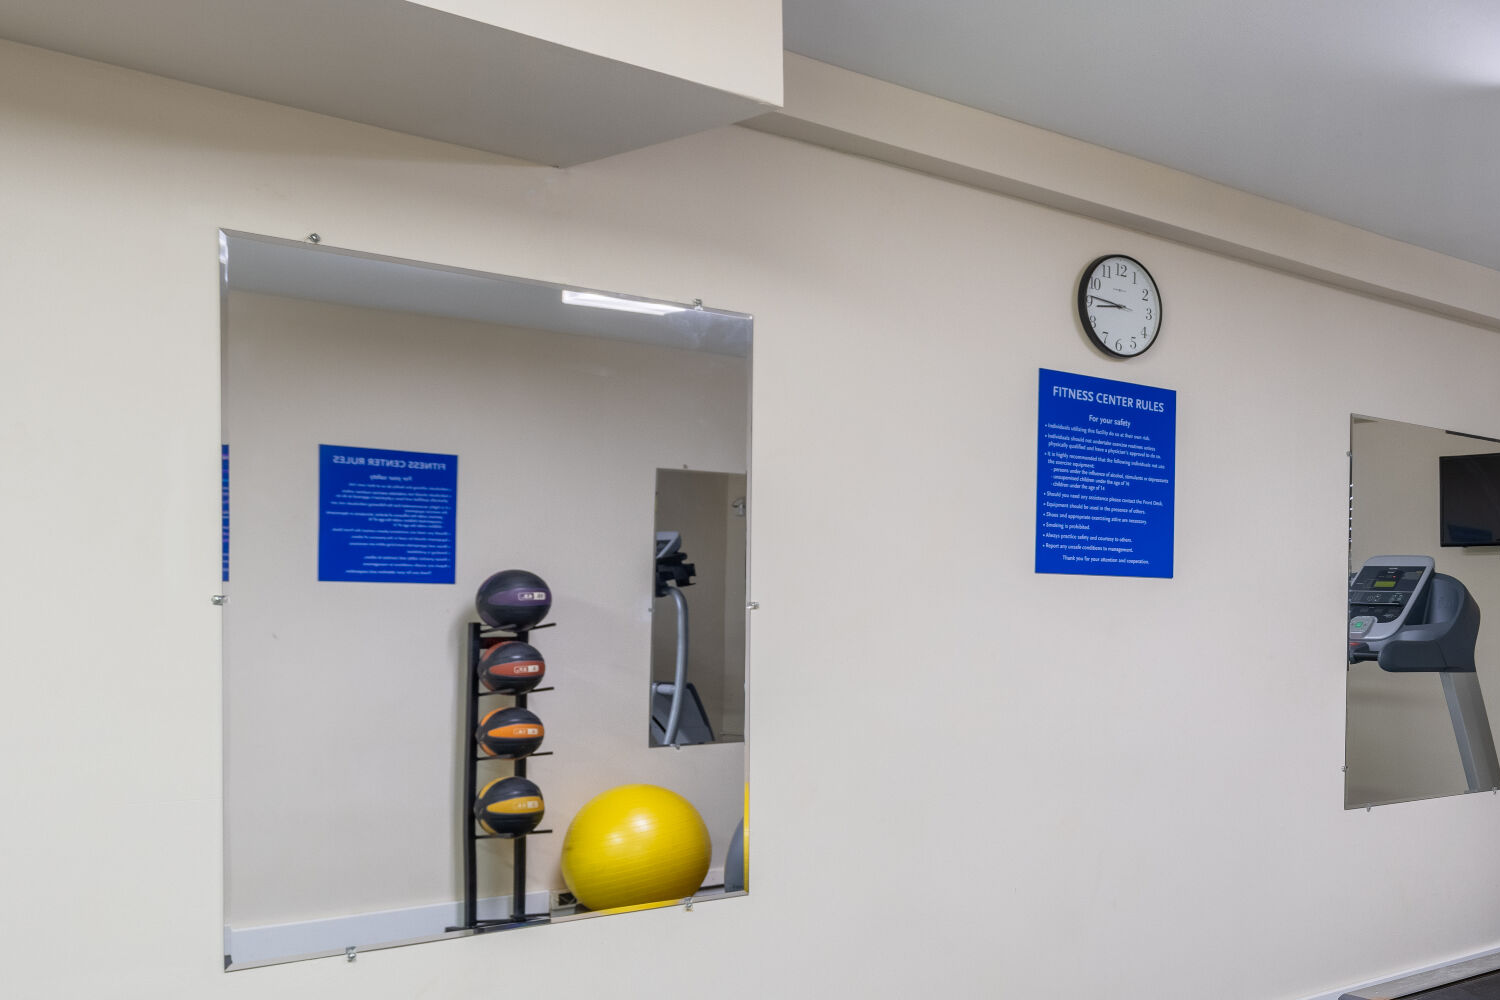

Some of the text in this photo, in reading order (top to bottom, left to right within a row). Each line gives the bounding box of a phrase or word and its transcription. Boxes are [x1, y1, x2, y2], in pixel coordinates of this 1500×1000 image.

[1102, 264, 1111, 278] 11
[1116, 262, 1128, 278] 12
[1090, 278, 1101, 290] 10
[1132, 272, 1137, 284] 1
[1086, 295, 1094, 307] 9
[1142, 289, 1149, 302] 2
[1146, 308, 1153, 320] 3
[1090, 315, 1097, 329] 8
[1102, 332, 1108, 344] 7
[1141, 326, 1147, 339] 4
[1115, 338, 1122, 351] 6
[1130, 337, 1137, 349] 5
[1053, 385, 1164, 413] FITNESS CENTER RULES
[1089, 414, 1131, 429] For your safety
